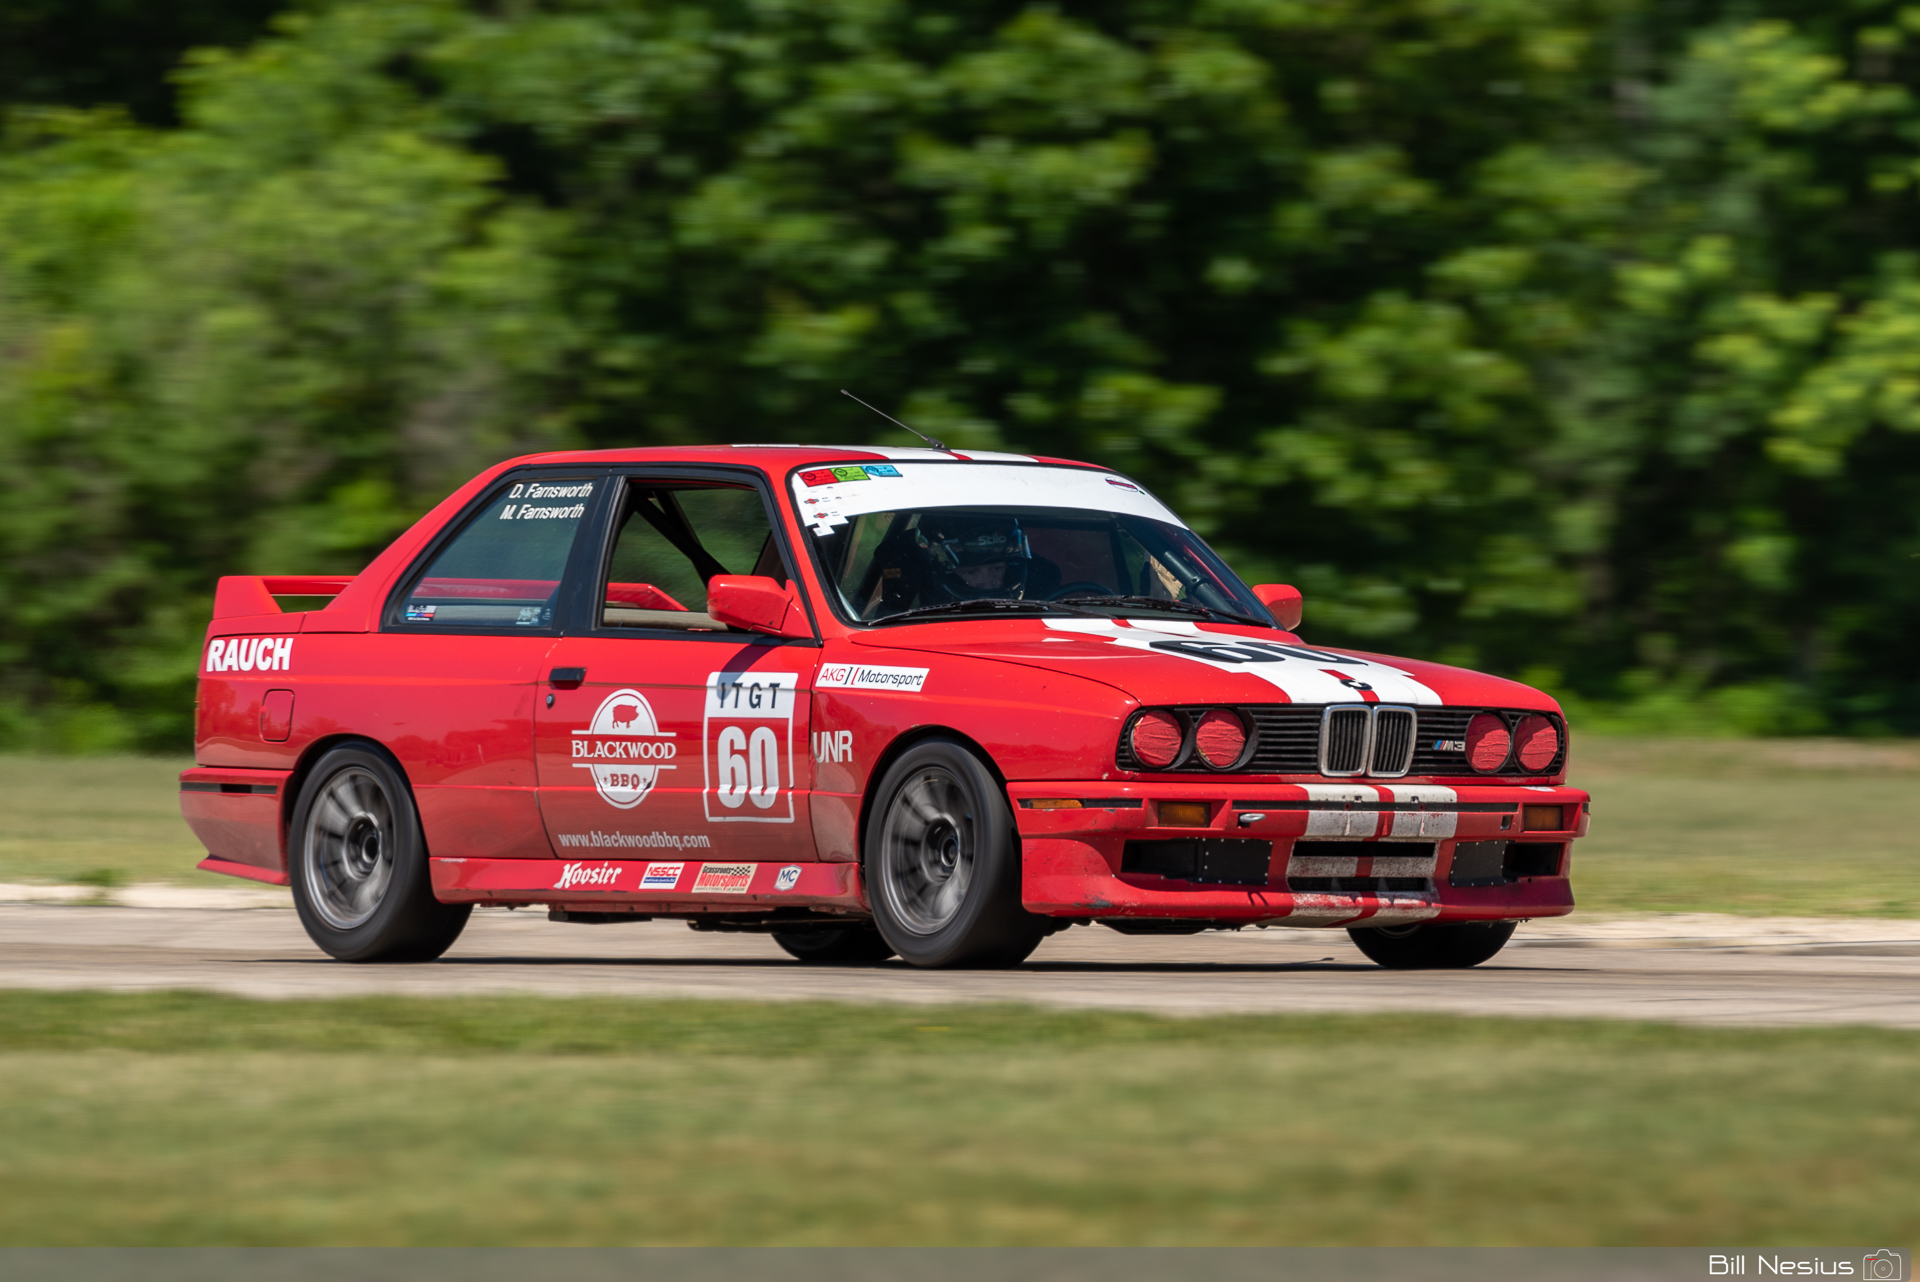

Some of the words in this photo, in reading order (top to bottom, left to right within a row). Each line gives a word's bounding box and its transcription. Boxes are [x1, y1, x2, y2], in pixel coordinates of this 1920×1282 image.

[508, 483, 523, 499] D.
[524, 482, 594, 499] Farnsworth
[499, 504, 516, 520] M.
[516, 503, 585, 520] Farnsworth
[205, 637, 294, 672] RAUCH
[1149, 640, 1368, 666] 60
[719, 682, 781, 709] ITGT
[571, 739, 677, 760] BLACKWOOD
[812, 729, 853, 764] UNR
[716, 725, 780, 809] 60
[609, 773, 641, 791] BBQ
[557, 830, 711, 851] www.blackwoodbbq.com
[552, 860, 623, 889] Hoosier
[646, 866, 682, 877] NSSCC
[701, 865, 732, 874] Grassroots
[778, 869, 798, 883] MC
[696, 872, 751, 891] Motorsports
